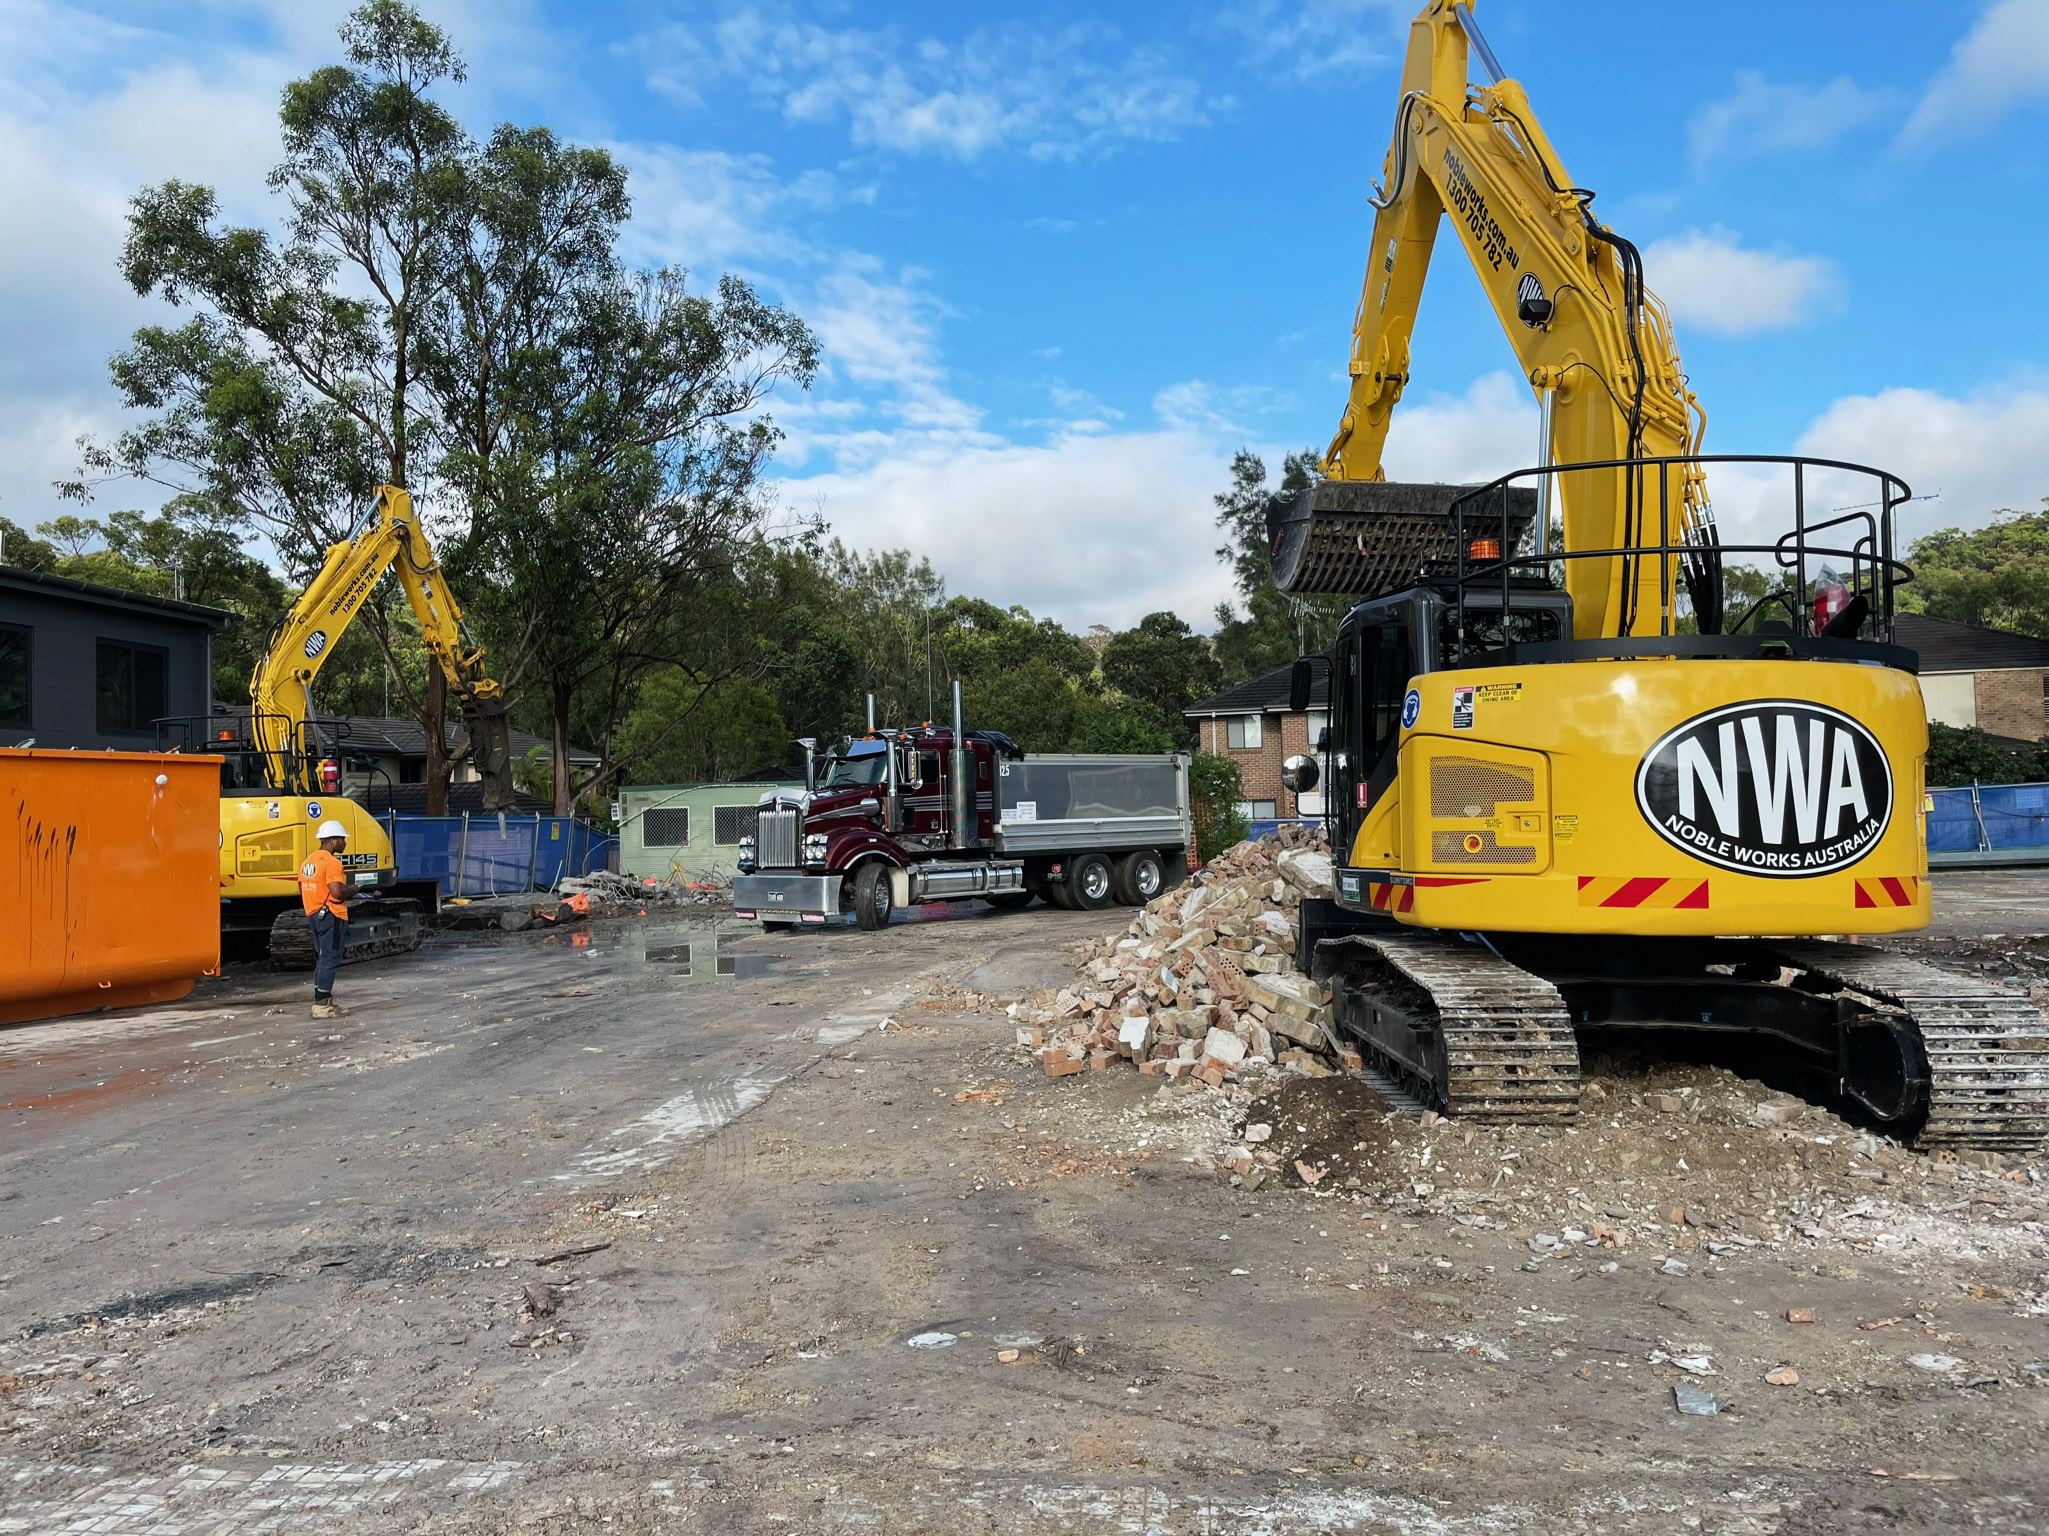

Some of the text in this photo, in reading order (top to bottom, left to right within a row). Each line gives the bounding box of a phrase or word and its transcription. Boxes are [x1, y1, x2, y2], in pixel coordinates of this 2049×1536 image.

[1444, 148, 1519, 270] nobleworks.com.au
[1445, 173, 1502, 272] 1300 705 782
[1520, 275, 1543, 304] NW
[330, 553, 379, 616] nobleworks.com.au
[342, 568, 377, 613] 1300 705 782
[305, 632, 325, 657] NWA
[1676, 714, 1869, 845] NWA
[1665, 814, 1880, 868] NOBLE WORKS AUSTRALIA
